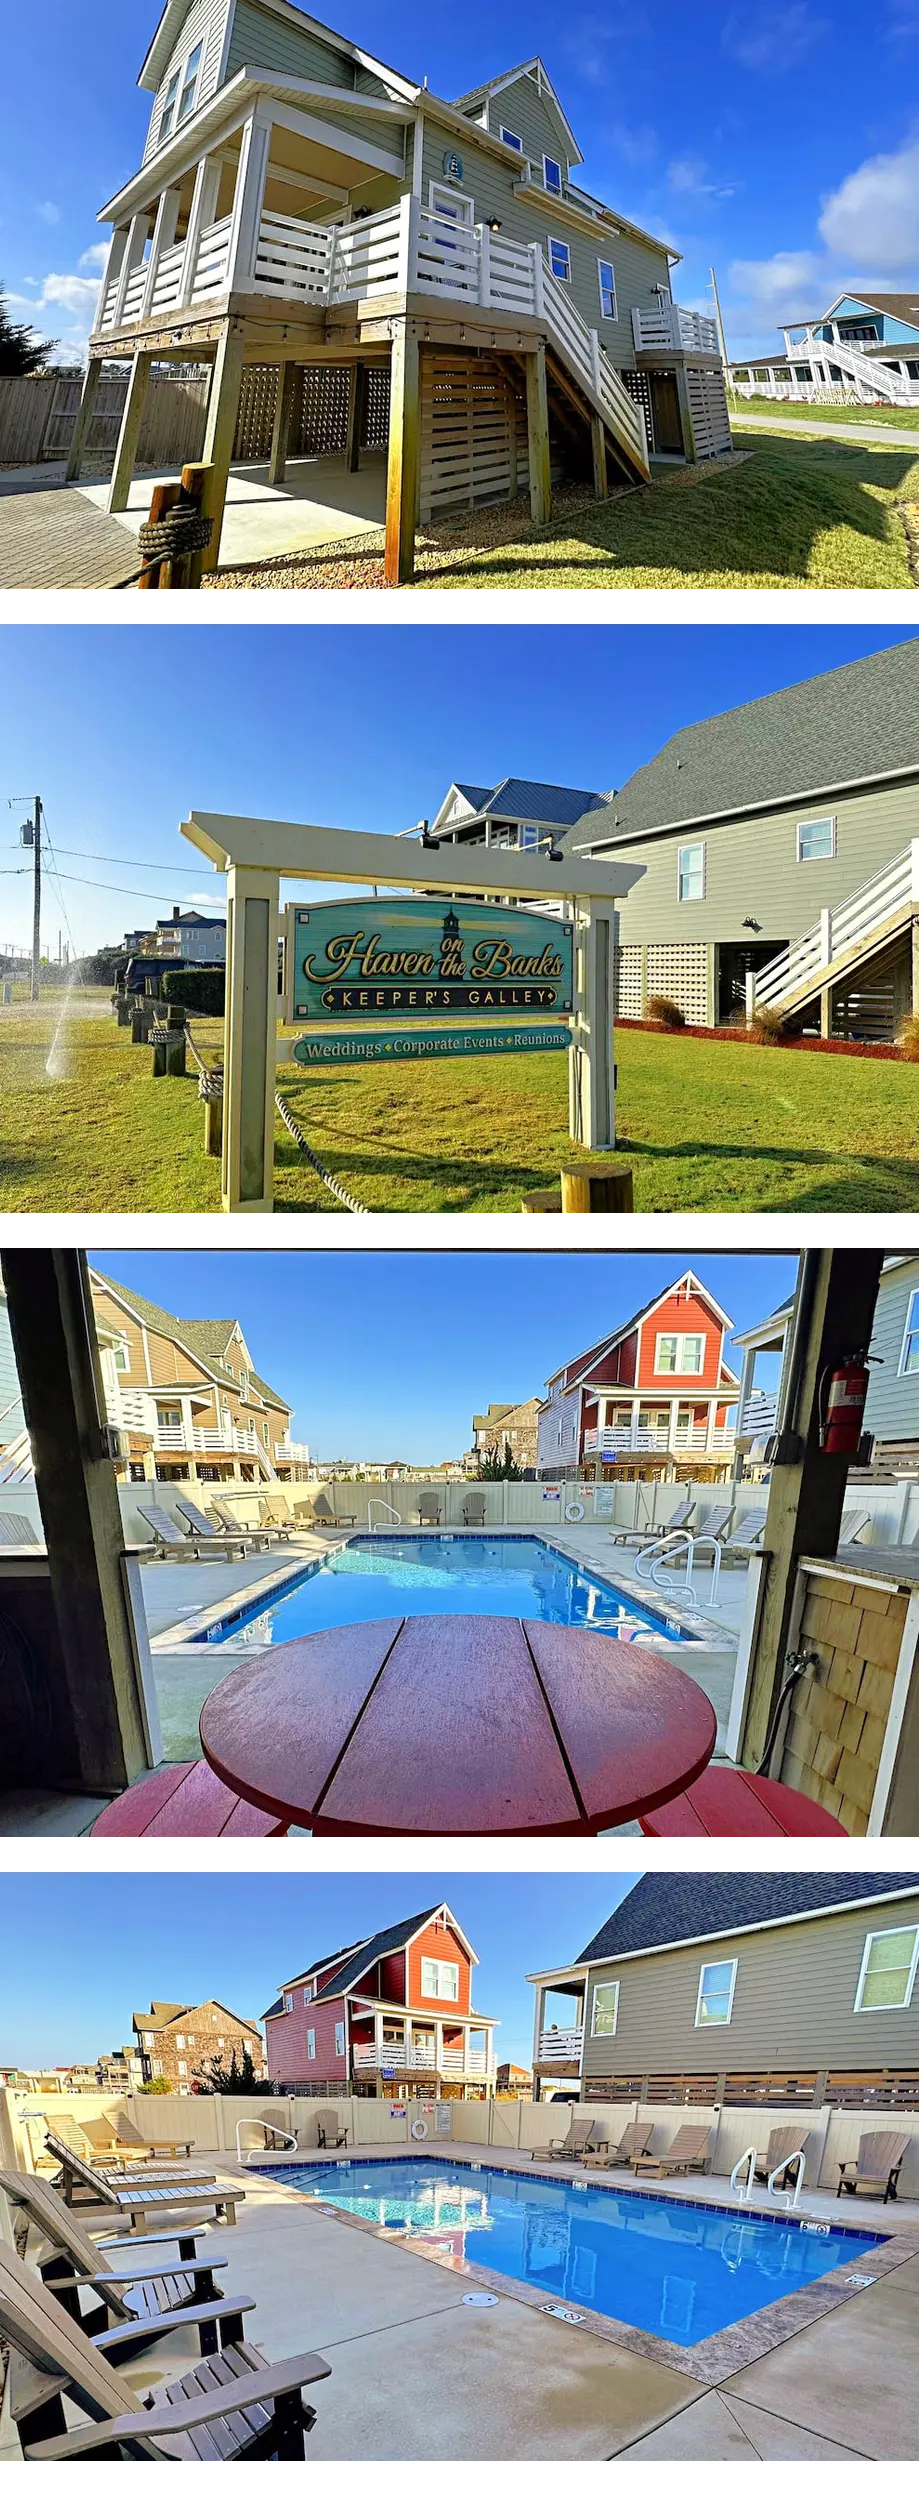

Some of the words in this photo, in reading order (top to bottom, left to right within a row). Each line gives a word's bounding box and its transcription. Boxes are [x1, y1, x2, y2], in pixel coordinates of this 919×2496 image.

[303, 931, 435, 984] Haven
[440, 937, 465, 953] on
[438, 952, 467, 977] the
[471, 939, 564, 979] Banks
[342, 990, 450, 1006] KEEPER'S
[468, 990, 545, 1004] GALLEY
[306, 1041, 382, 1058] Weddings
[393, 1038, 460, 1055] Corporate
[463, 1035, 504, 1049] Events
[513, 1032, 565, 1046] Reunions
